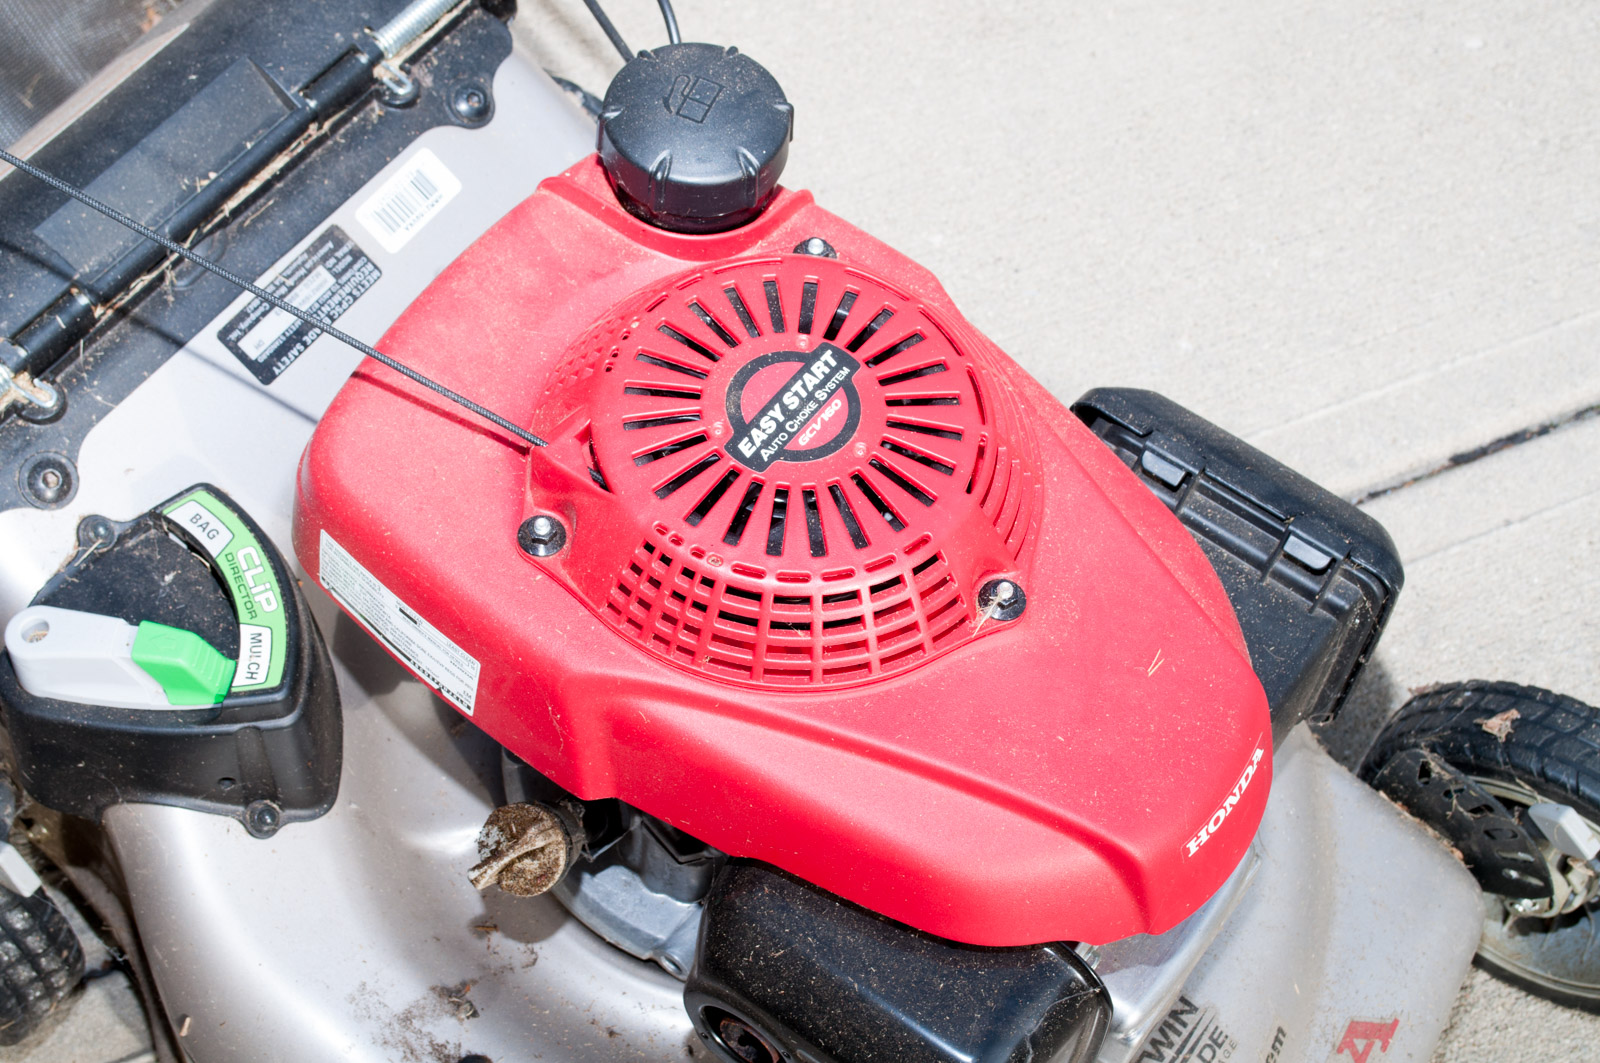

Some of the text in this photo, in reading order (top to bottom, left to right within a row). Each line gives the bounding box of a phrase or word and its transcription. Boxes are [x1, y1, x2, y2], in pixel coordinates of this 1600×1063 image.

[350, 267, 381, 297] MEETS
[329, 294, 354, 319] CPSC
[302, 315, 332, 345] BADE
[271, 342, 305, 375] SAFETY
[737, 349, 837, 458] EASY START
[798, 398, 842, 446] GCV160
[189, 512, 220, 541] BAG
[224, 552, 258, 620] DIRECTOR
[245, 632, 263, 681] MULCH
[1186, 748, 1264, 858] HONDA
